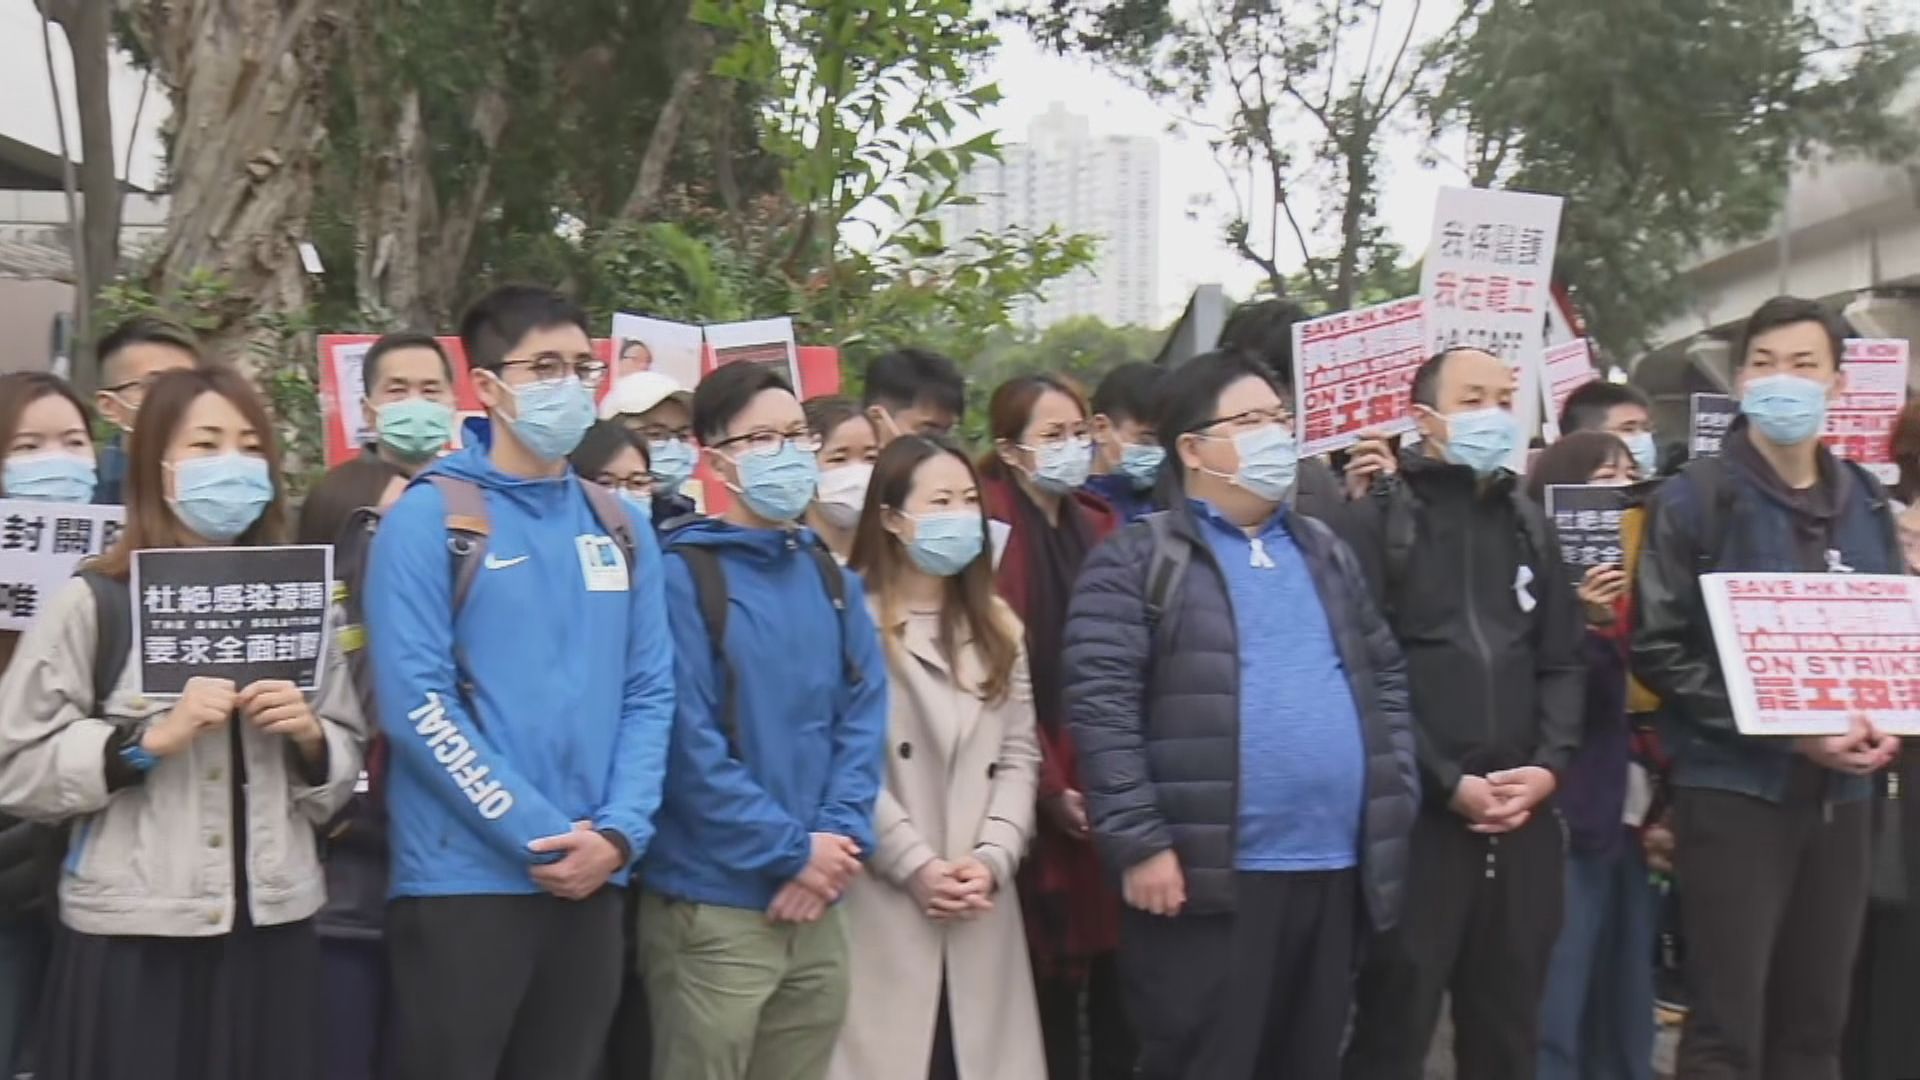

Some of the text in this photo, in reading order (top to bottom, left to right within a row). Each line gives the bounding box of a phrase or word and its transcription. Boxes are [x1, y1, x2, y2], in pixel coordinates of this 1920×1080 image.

[1434, 272, 1535, 313] 我在罷工
[1302, 300, 1424, 339] SAVE HK NOW
[1305, 388, 1337, 410] ON
[144, 582, 324, 614] 杜絕感染源頭
[1726, 580, 1907, 595] SAVE HK NOW
[151, 616, 321, 630] THE ONLY SOLUTION
[1746, 655, 1795, 675] ON
[407, 691, 514, 820] OFFICIAL
